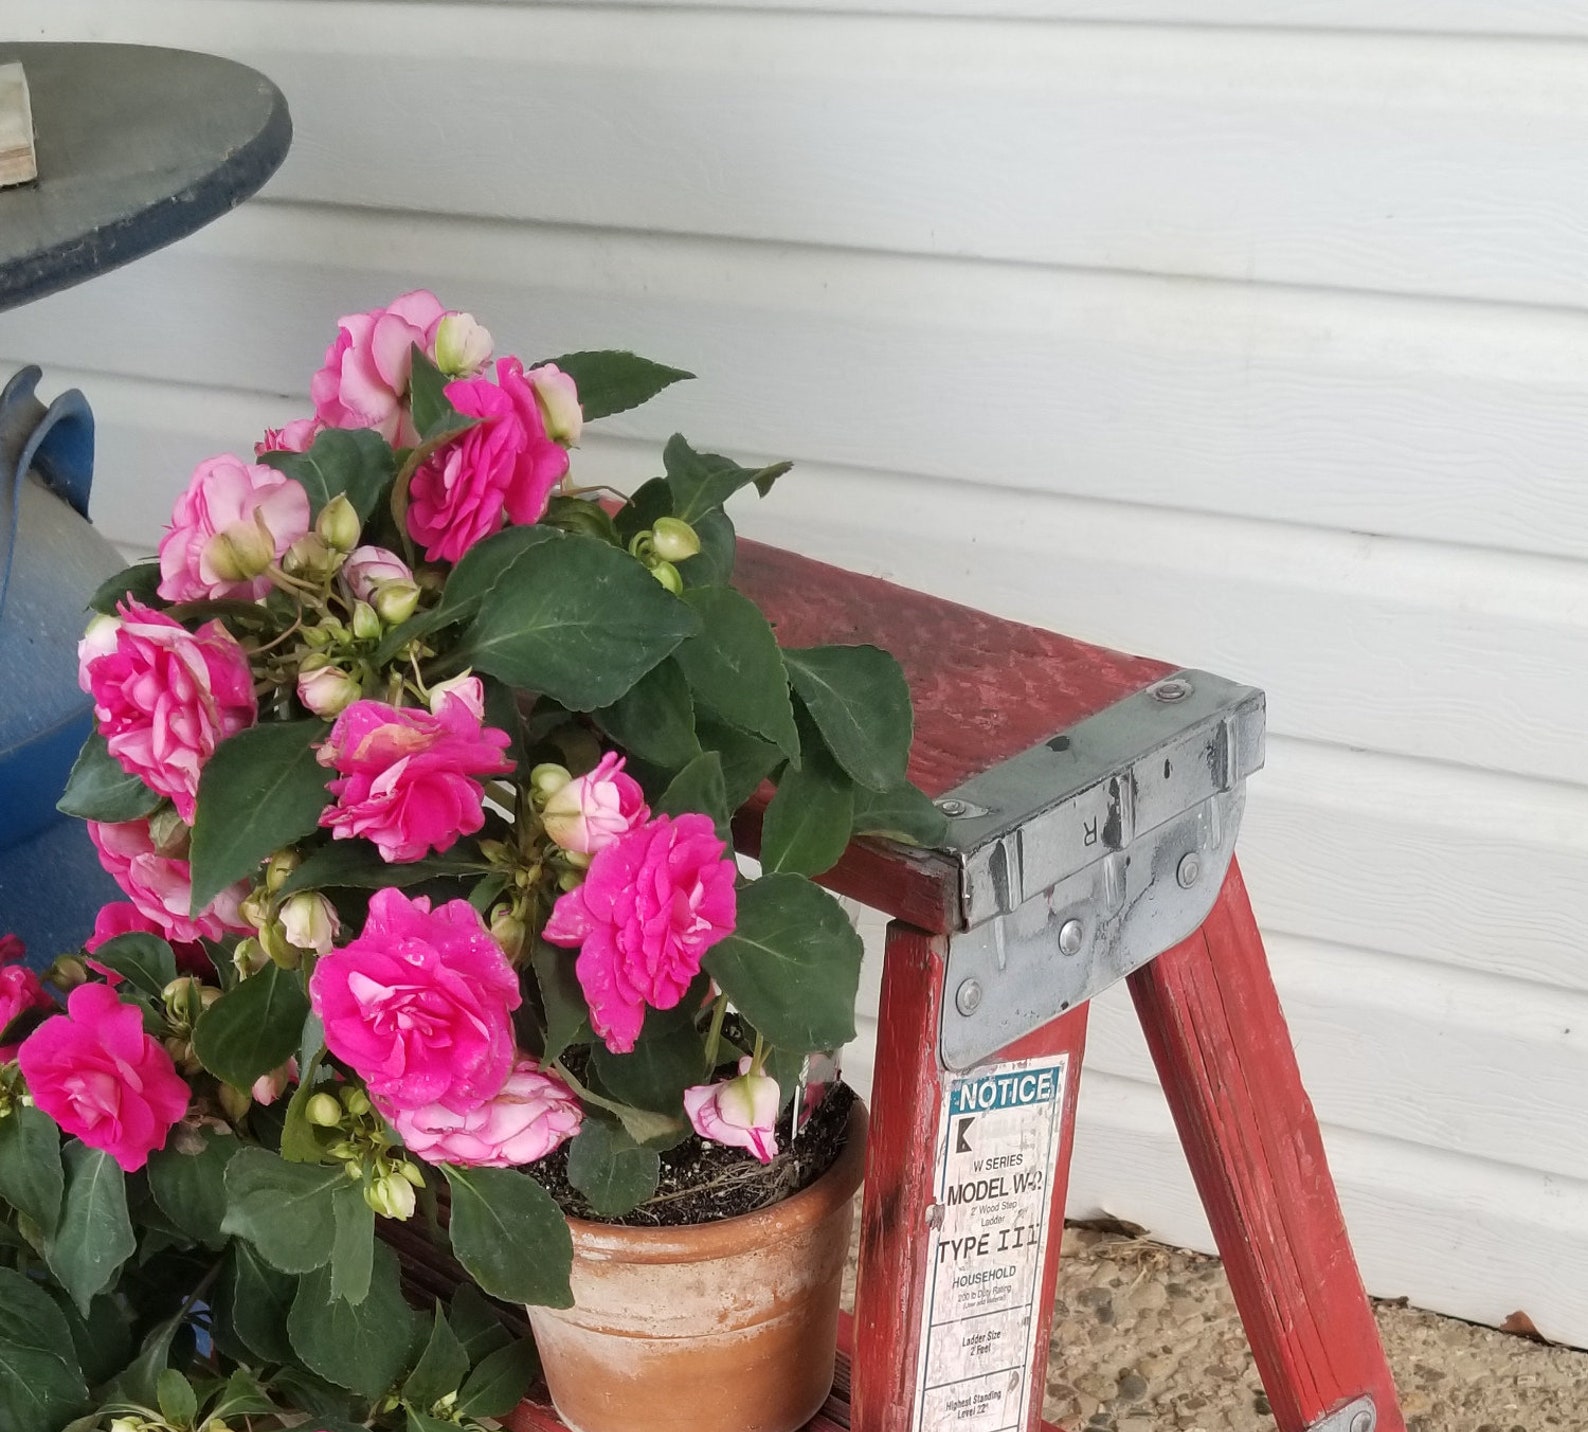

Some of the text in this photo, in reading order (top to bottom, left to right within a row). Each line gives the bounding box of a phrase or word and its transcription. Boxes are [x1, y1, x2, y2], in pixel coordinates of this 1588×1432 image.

[1084, 815, 1097, 847] R
[959, 1073, 1051, 1112] NOTICE
[973, 1153, 1024, 1173] W SERIES
[947, 1176, 1009, 1206] MODEL
[979, 1202, 1000, 1215] Wood
[1001, 1200, 1018, 1211] Step
[981, 1215, 1006, 1227] Ladder
[939, 1223, 1040, 1264] TYPE III
[952, 1265, 1017, 1290] HOUSEHOLD
[992, 1284, 1012, 1295] Rating
[961, 1330, 1002, 1348] Ladder Size
[970, 1343, 992, 1356] 2 Feet
[945, 1390, 1002, 1412] Highest Standing
[957, 1408, 976, 1420] Level
